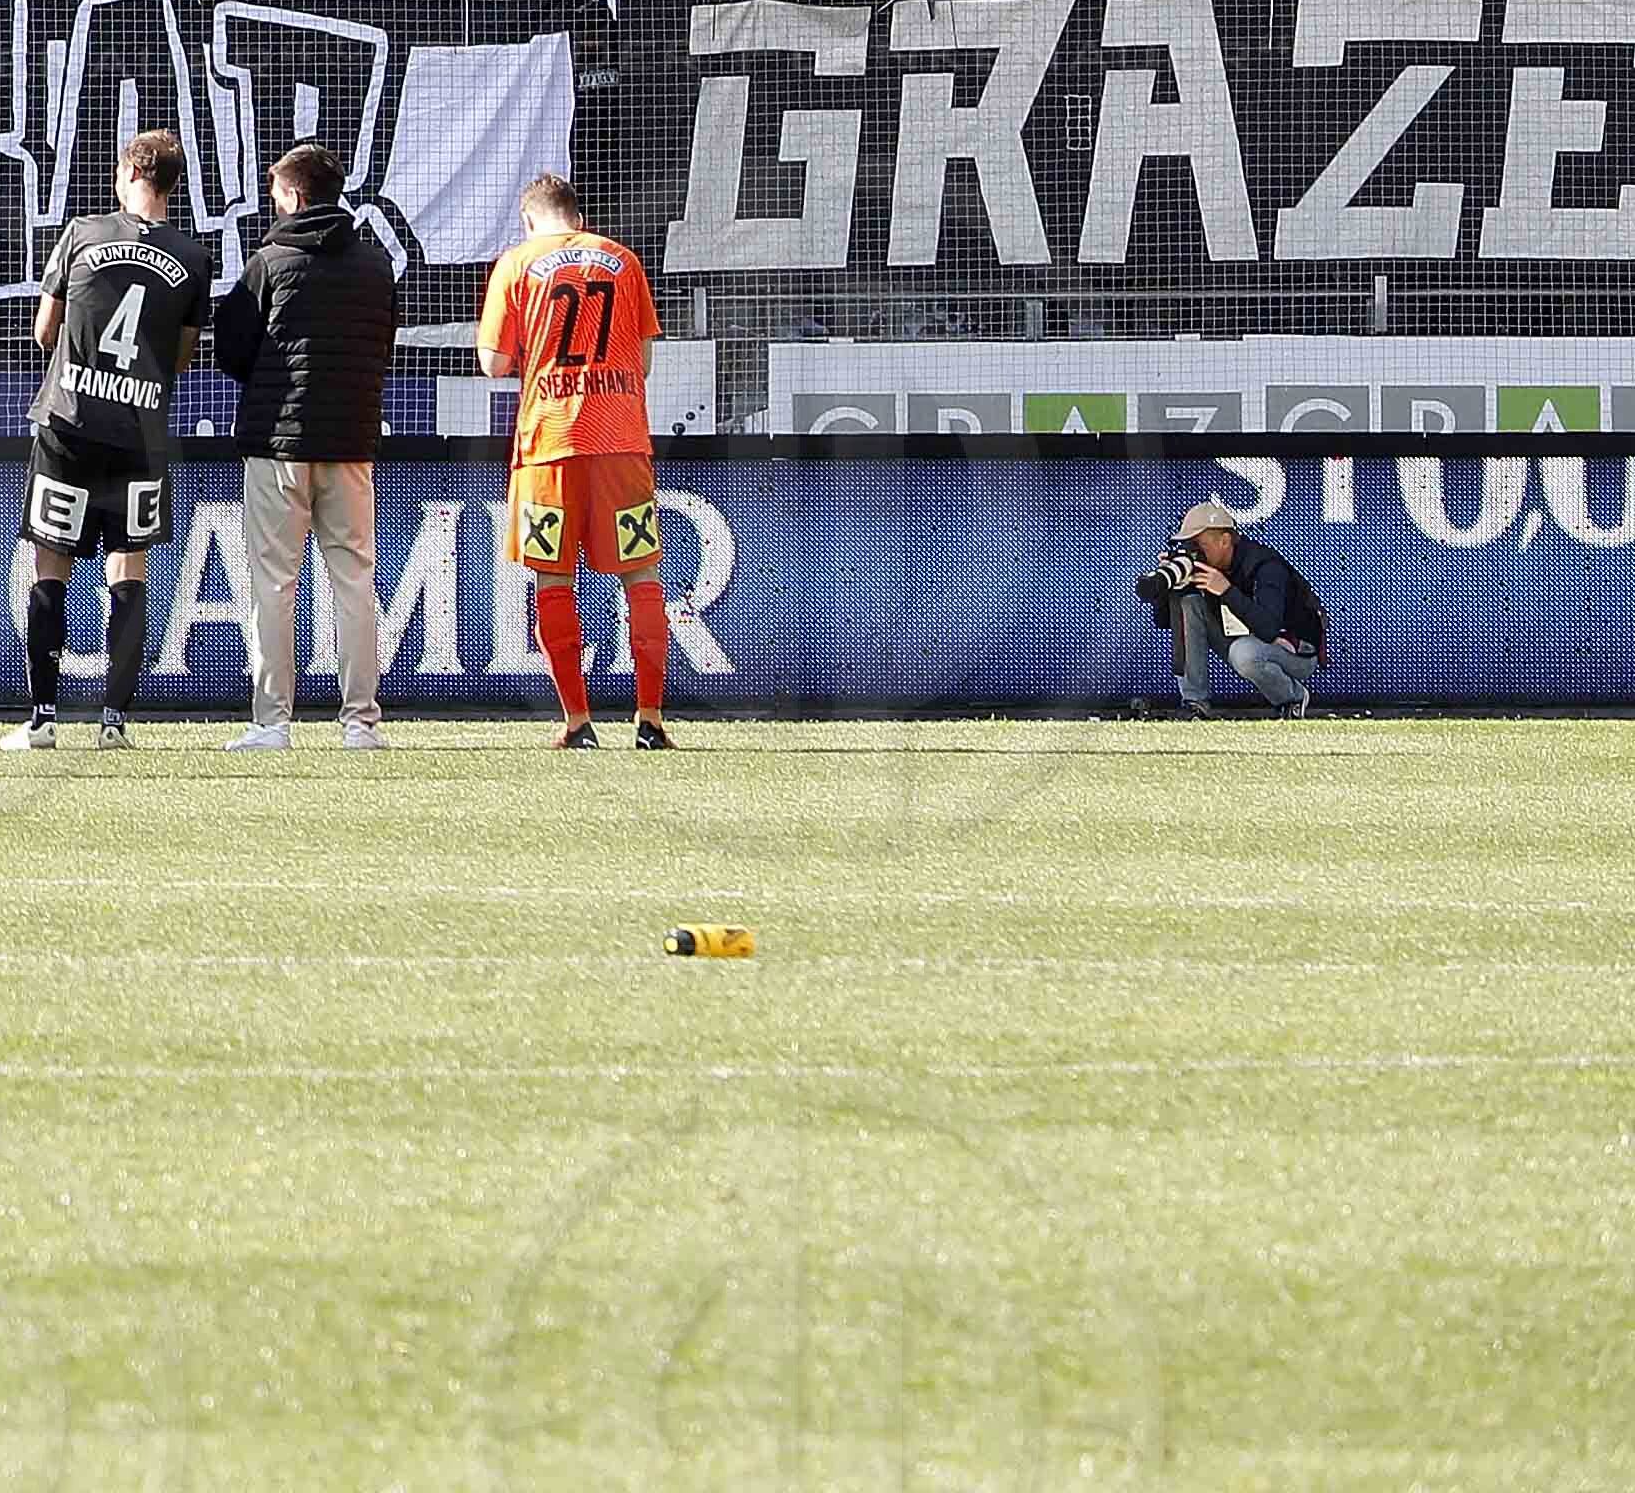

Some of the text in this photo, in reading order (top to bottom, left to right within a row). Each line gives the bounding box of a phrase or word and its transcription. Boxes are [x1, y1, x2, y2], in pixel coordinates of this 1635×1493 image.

[91, 245, 182, 286] PUNTIGAMER
[531, 249, 622, 279] PUNTIGAMER
[98, 284, 146, 371] 4
[549, 280, 616, 368] 27
[59, 363, 164, 411] STANKOVIC
